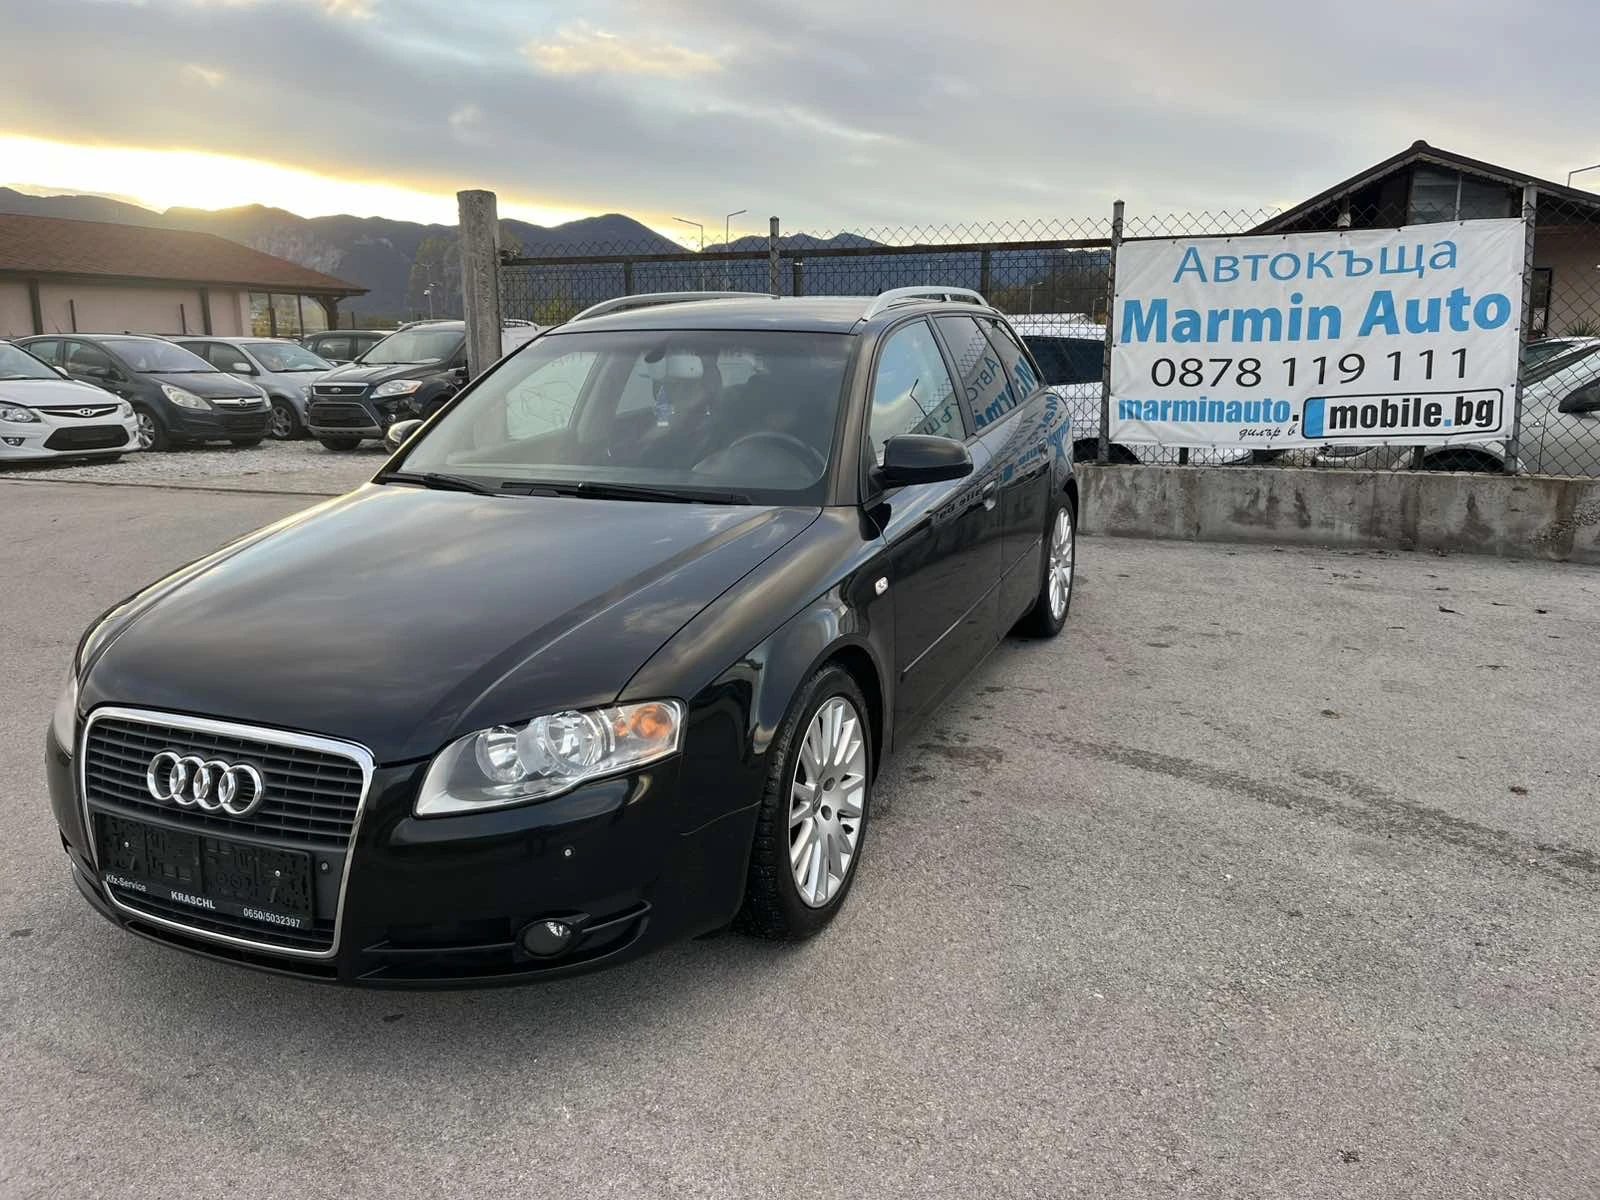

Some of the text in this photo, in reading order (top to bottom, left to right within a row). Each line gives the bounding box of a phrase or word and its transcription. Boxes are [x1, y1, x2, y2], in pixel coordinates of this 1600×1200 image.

[1172, 240, 1458, 284] Автокъща
[1120, 286, 1512, 343] Marmin Auto
[1151, 347, 1469, 388] 0878 119 111
[1329, 396, 1495, 430] mobile.bg
[105, 873, 148, 892] Kfz-Service
[170, 890, 216, 910] KRASCHL
[243, 907, 301, 928] 0650/5032397
